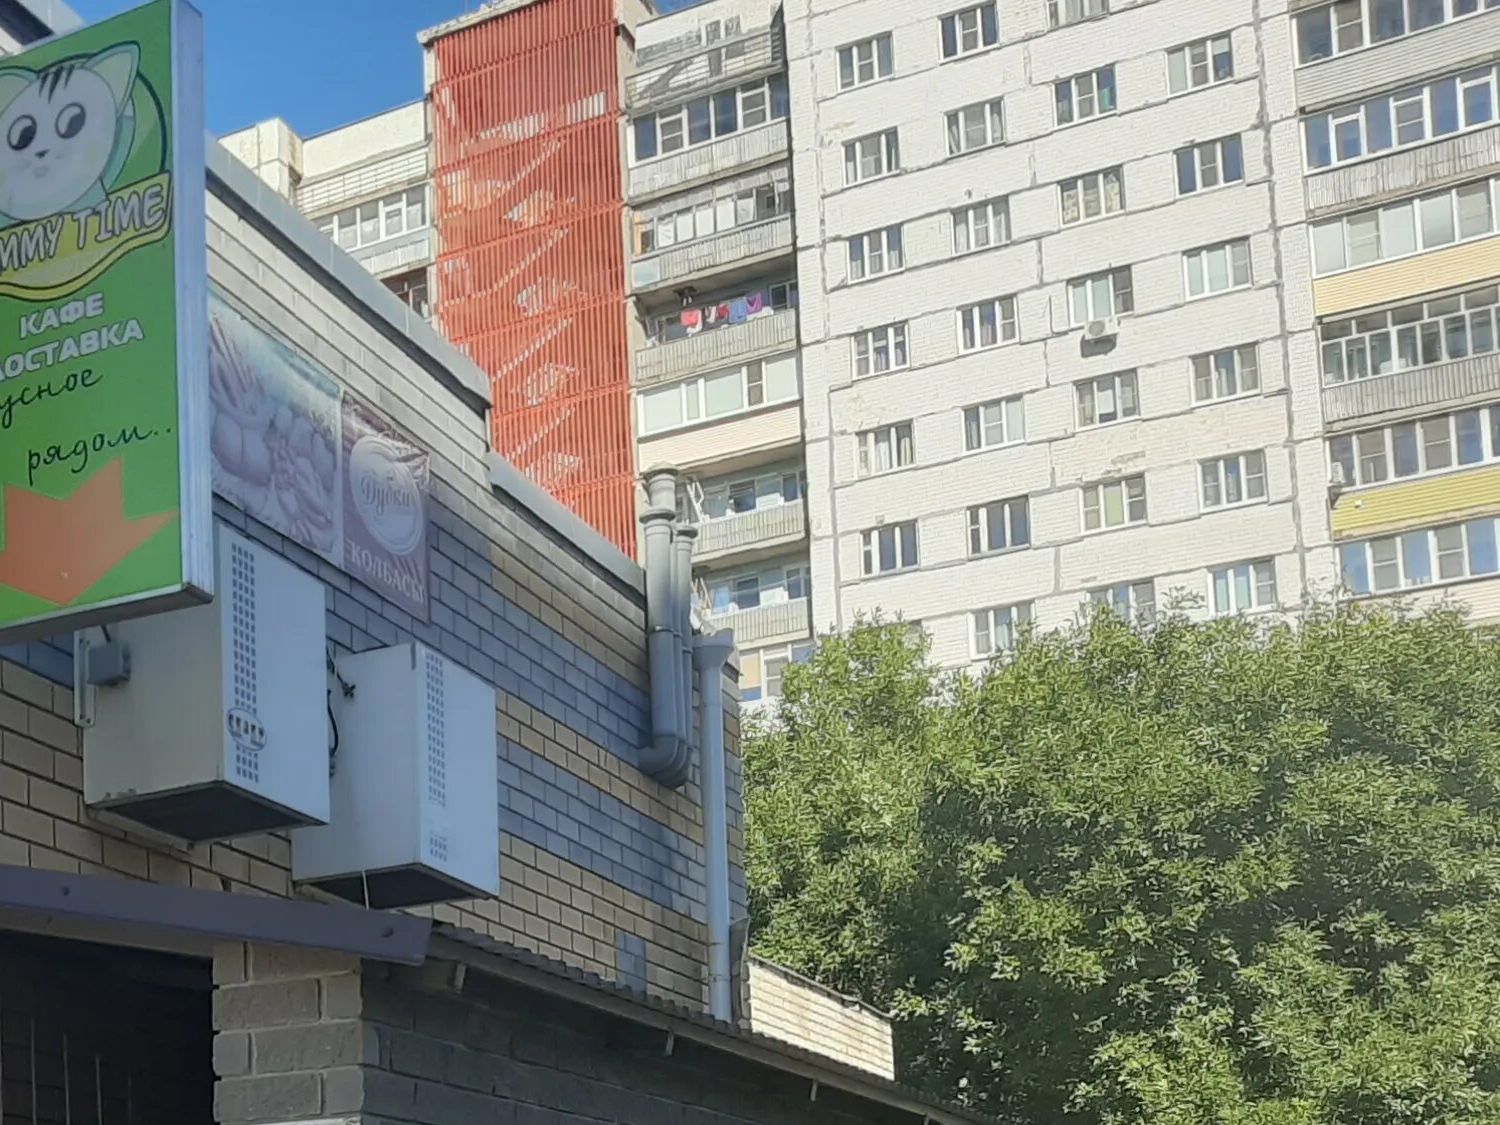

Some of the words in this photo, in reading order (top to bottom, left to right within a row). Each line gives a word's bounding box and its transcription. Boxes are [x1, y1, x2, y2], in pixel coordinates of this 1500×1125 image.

[73, 183, 166, 250] TIME
[19, 293, 105, 338] КАФЕ
[351, 543, 424, 602] КОЛБАСЫ
